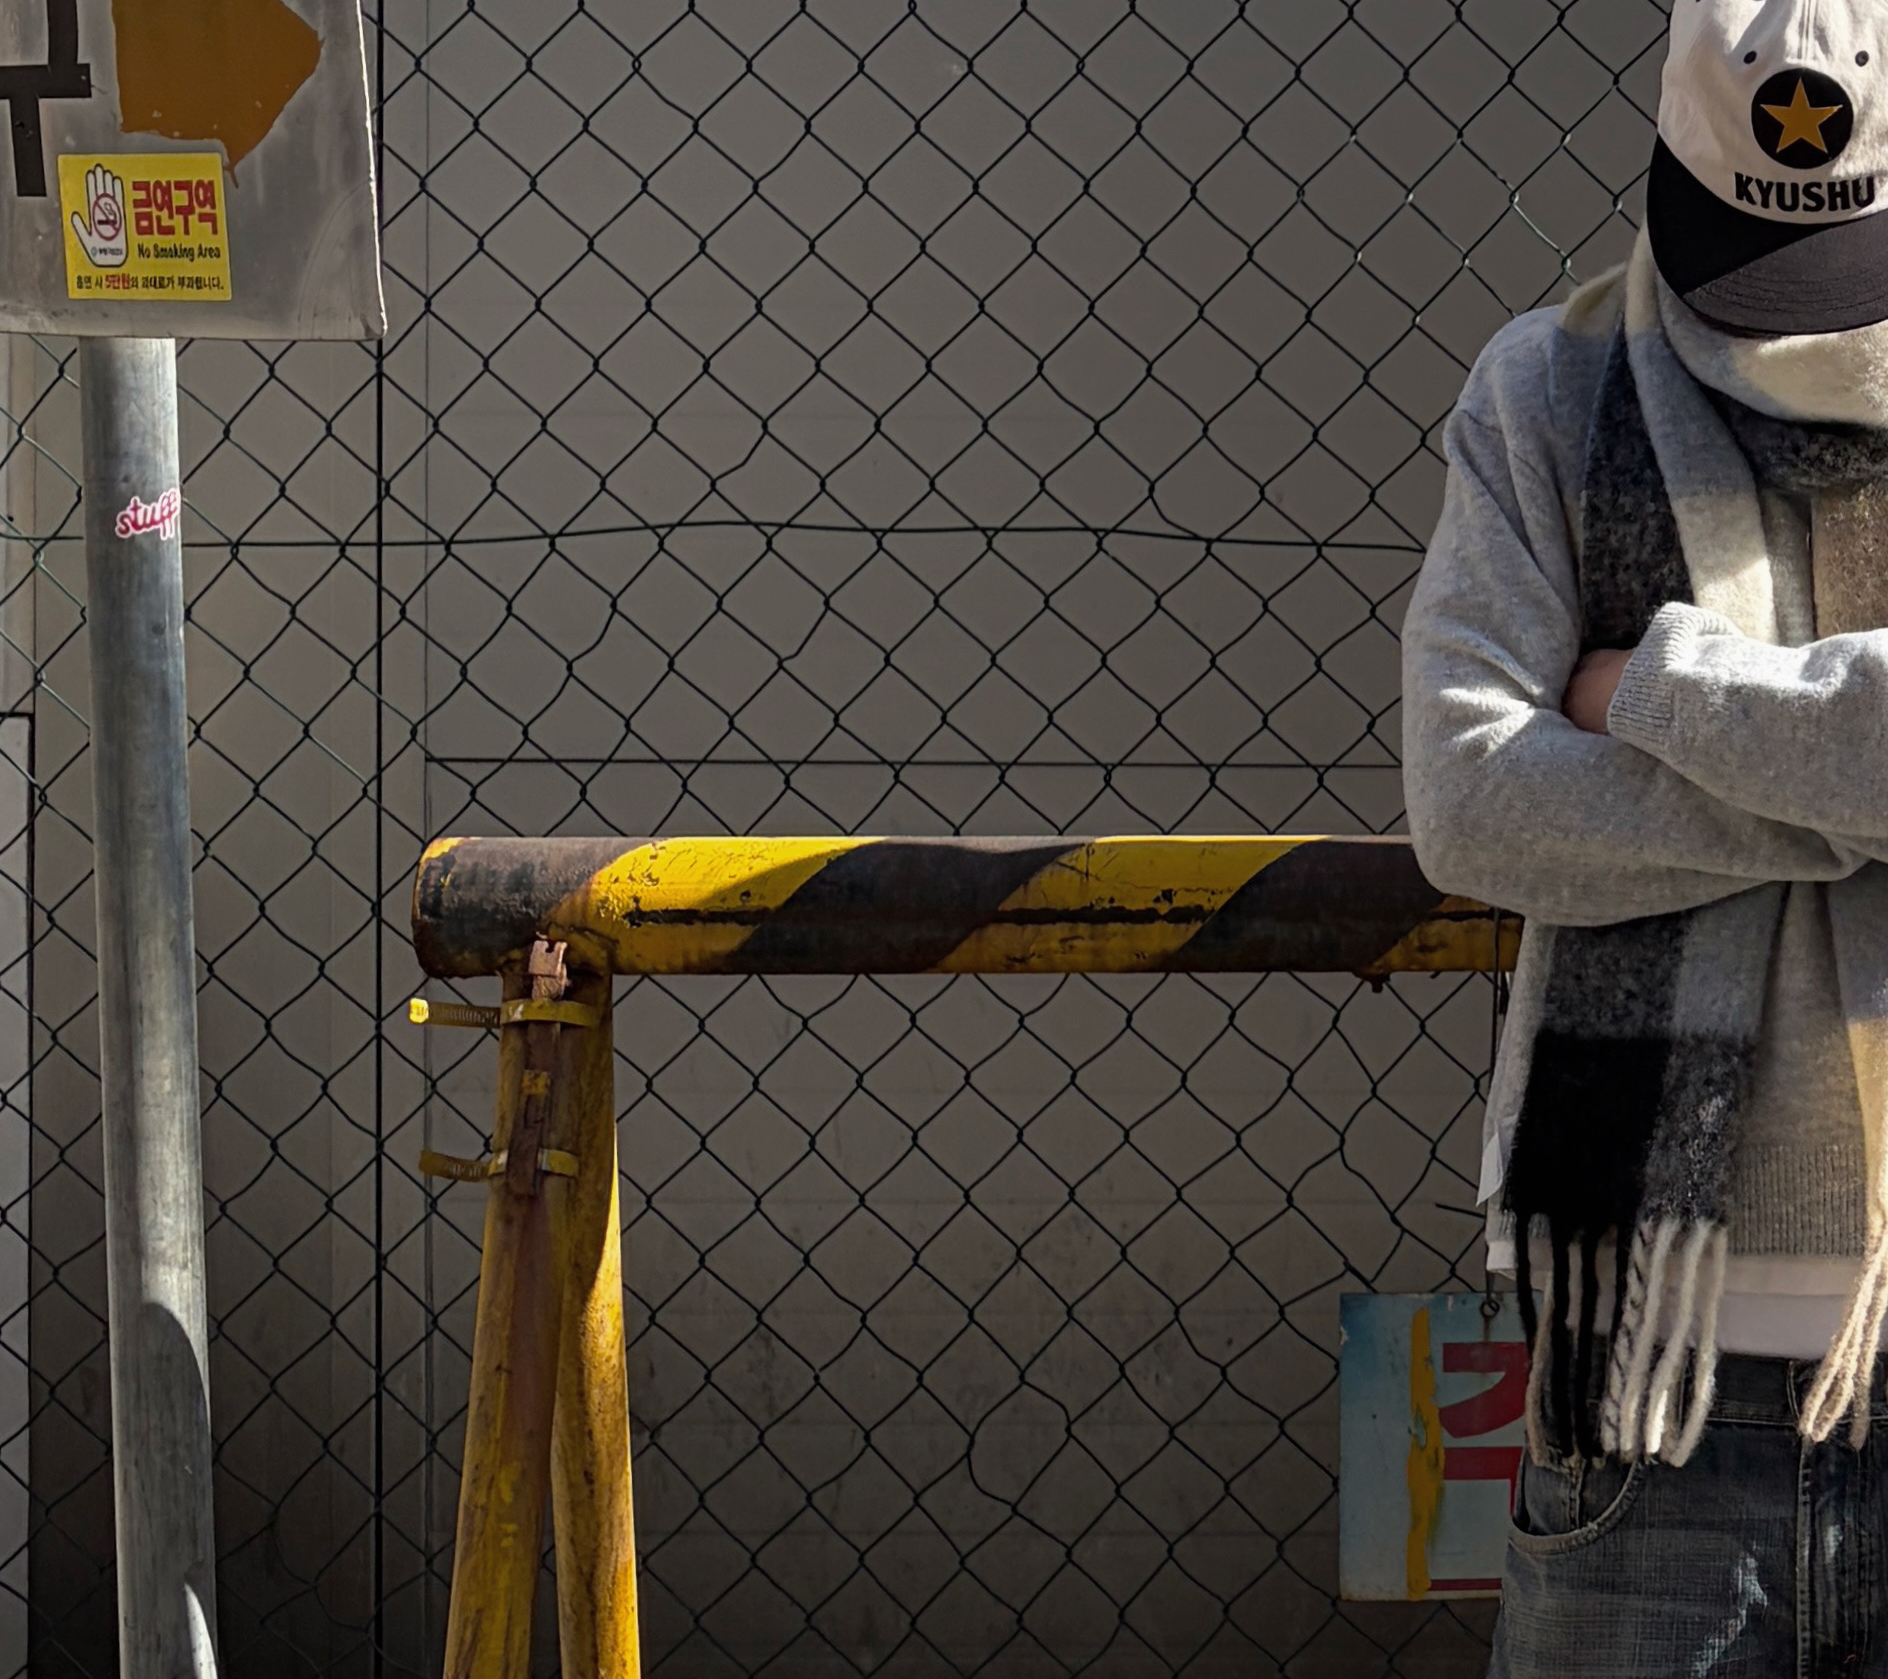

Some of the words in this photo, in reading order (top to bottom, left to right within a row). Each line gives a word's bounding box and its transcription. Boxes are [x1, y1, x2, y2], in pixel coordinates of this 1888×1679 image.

[132, 179, 218, 236] 금연구역
[1734, 171, 1877, 213] KYUSHU
[137, 243, 151, 258] No
[153, 243, 195, 263] Smoking
[197, 243, 221, 259] Area
[117, 490, 180, 539] stuff
